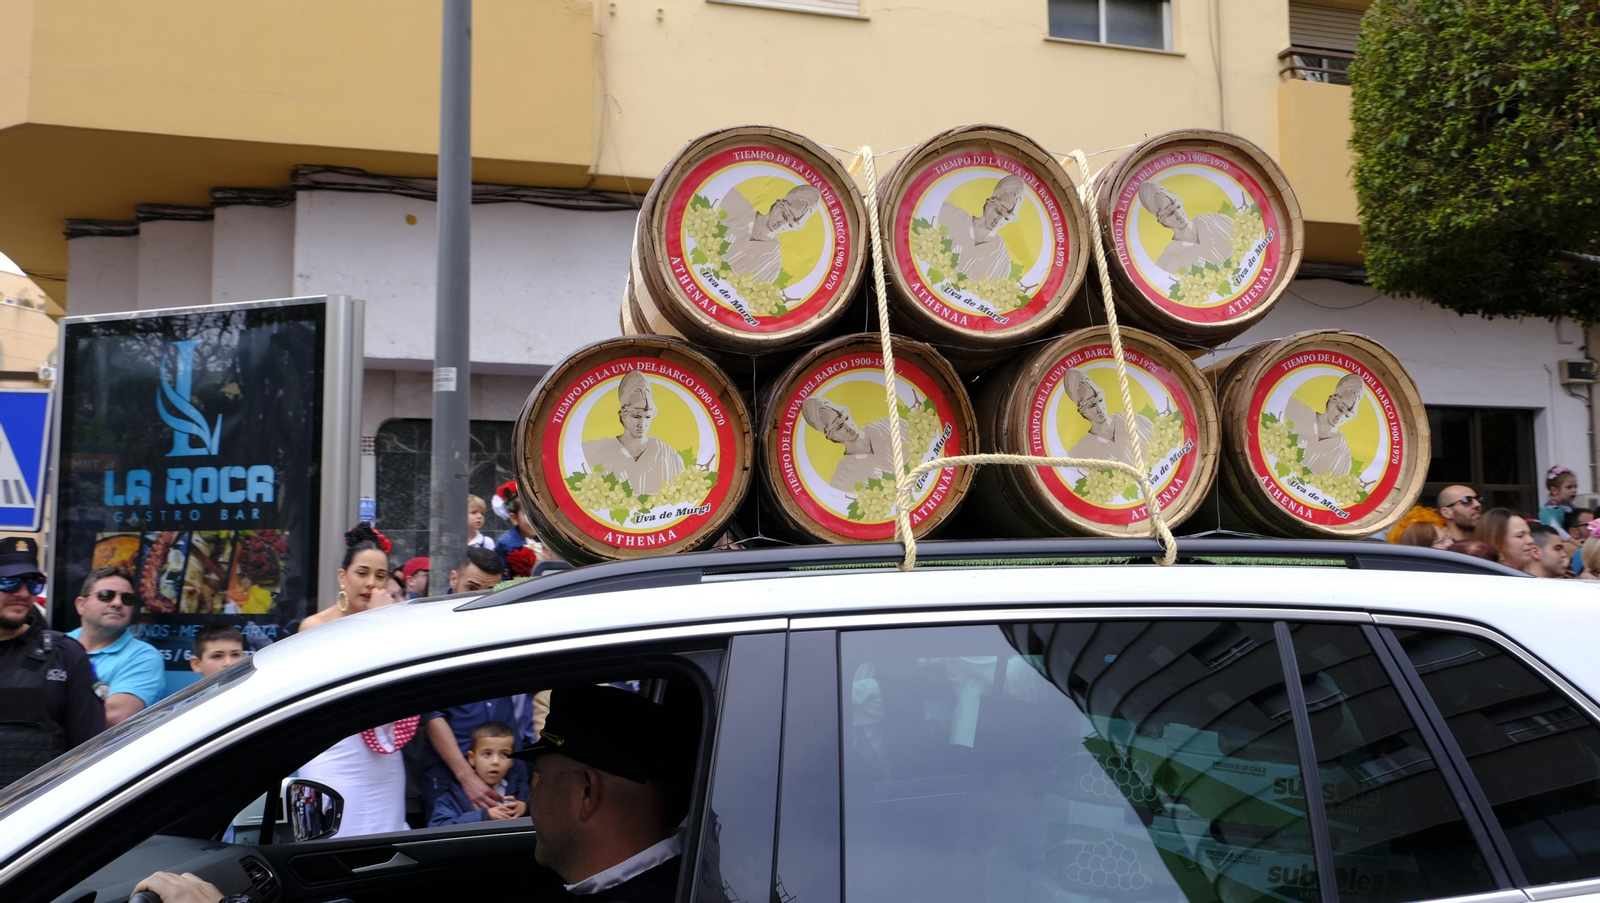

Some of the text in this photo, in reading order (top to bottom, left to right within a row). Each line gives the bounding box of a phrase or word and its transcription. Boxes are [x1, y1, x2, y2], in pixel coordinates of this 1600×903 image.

[733, 150, 846, 290] TIEMPO DE LA UVA DEL BARCO 1900-1970
[934, 156, 1065, 267] TIEMPO DE LA UVA DEL BARCO 1900-1970
[1115, 155, 1230, 266] TIEMPO DE LA UVA DEL BARCO 1900-1970
[1235, 229, 1276, 284] Uva de Murgi
[671, 256, 718, 315] ATHENAA
[702, 271, 759, 327] Uva de Murgi
[911, 282, 968, 325] ATHENAA
[1228, 267, 1273, 315] ATHENAA
[944, 286, 1009, 324] Uva de Murgi
[815, 360, 848, 381] BARCO
[1050, 367, 1067, 383] UVA
[1066, 355, 1085, 368] DEL
[1122, 351, 1158, 373] 900-1970
[553, 362, 726, 426] TIEMPO DE LA UVA DEL BARCO 1900-1970
[799, 380, 817, 398] DEL
[1035, 397, 1045, 413] DE
[1043, 383, 1053, 397] LA
[788, 399, 803, 418] UVA
[1281, 354, 1400, 464] TIEMPO DE LA UVA DEL BARCO 1900-1970
[782, 437, 790, 451] DE
[784, 420, 793, 435] LA
[934, 422, 953, 456] Murgi
[1032, 413, 1043, 452] TIEMPO
[783, 456, 802, 495] TIEMPO
[1160, 463, 1170, 476] de
[1170, 440, 1194, 466] Murgi
[103, 465, 275, 506] LA ROCA
[913, 465, 954, 524] ATHENAA
[1131, 478, 1184, 520] ATENAA
[1260, 475, 1313, 519] ATHENAA
[1290, 480, 1350, 519] Uva de Murgi
[112, 508, 260, 523] GASTRO BAR
[635, 503, 711, 524] Uva de Murgi
[604, 530, 677, 546] ATHENAA
[1212, 761, 1240, 770] PRODUCE
[1250, 765, 1267, 773] CHILE
[1273, 776, 1380, 807] susole
[1205, 849, 1234, 859] PRODUCE
[1266, 863, 1374, 894] subole
